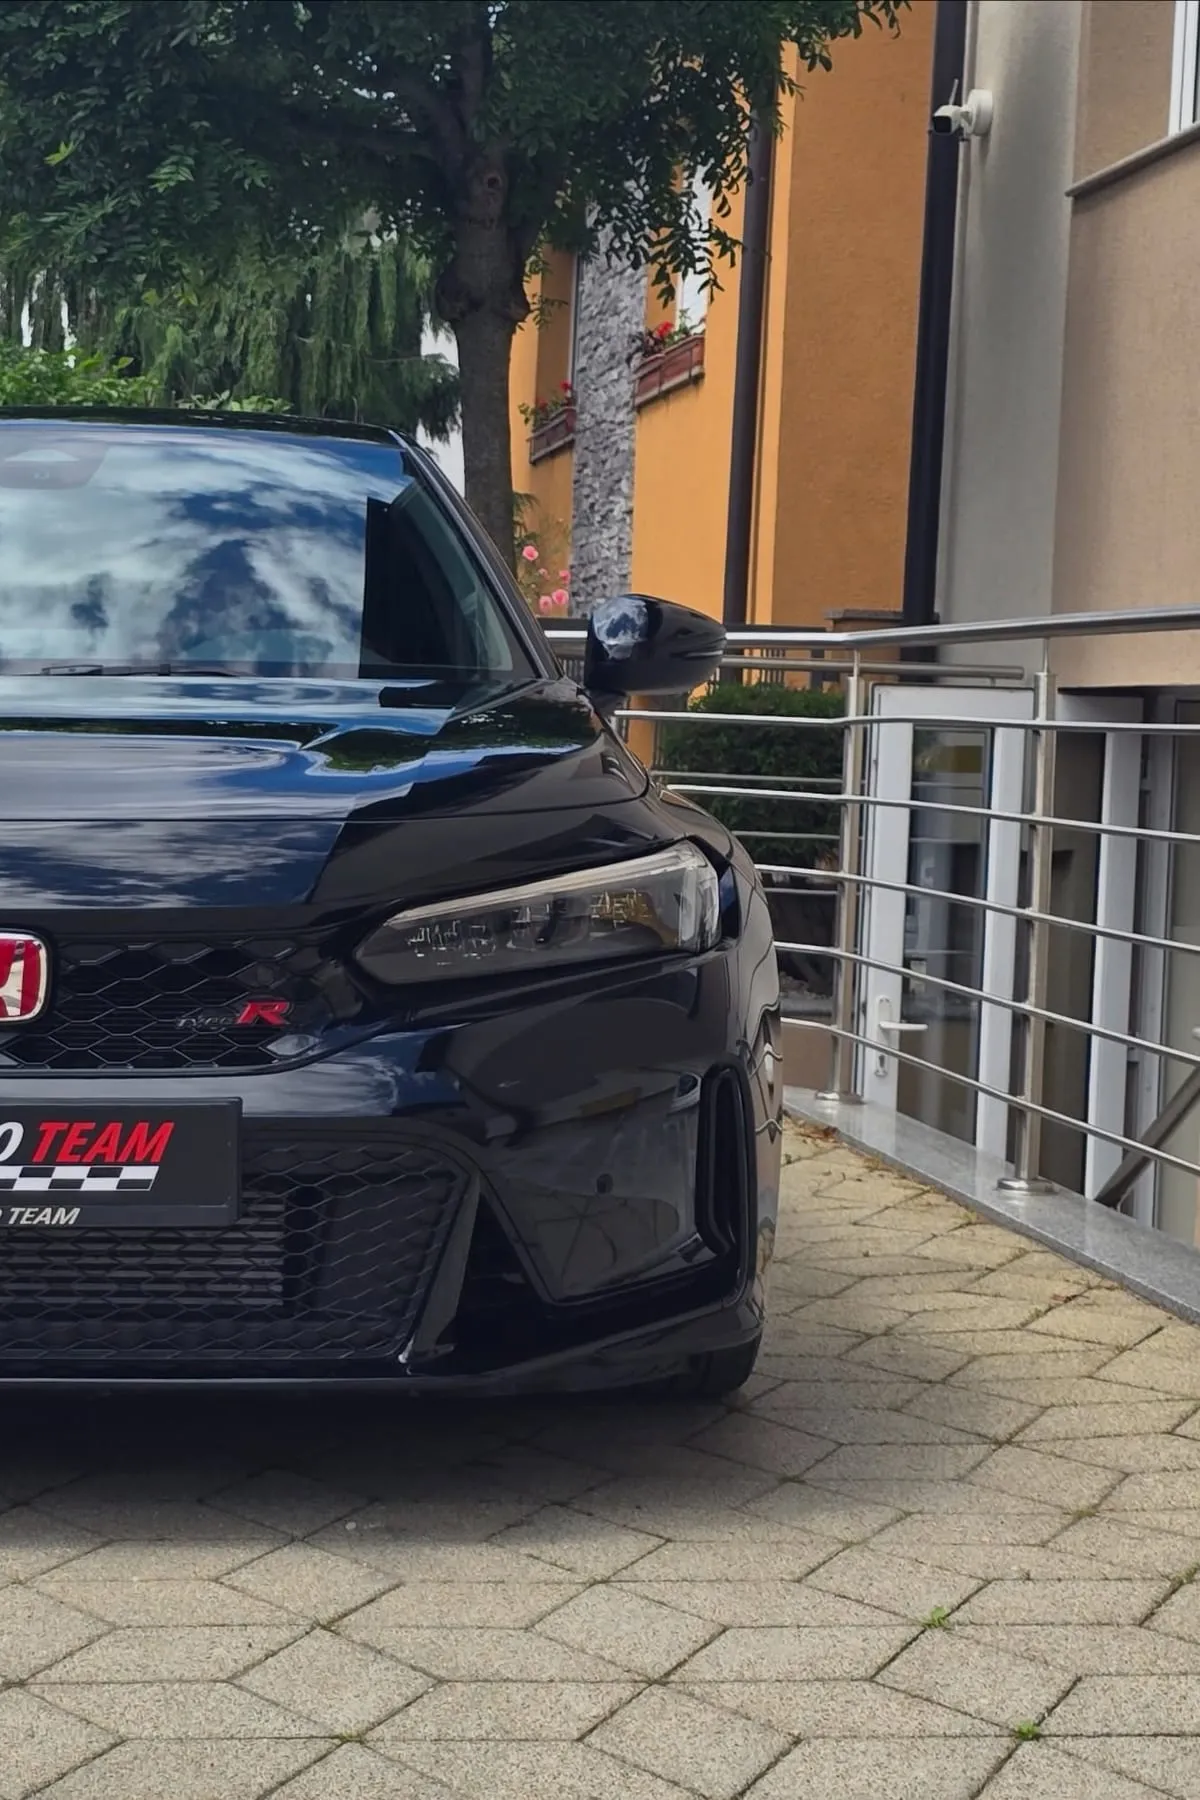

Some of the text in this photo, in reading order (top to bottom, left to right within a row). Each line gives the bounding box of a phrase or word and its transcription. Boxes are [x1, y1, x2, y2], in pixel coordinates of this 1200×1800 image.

[235, 1001, 290, 1026] R
[31, 1120, 175, 1164] TEAM
[7, 1206, 81, 1225] TEAM
